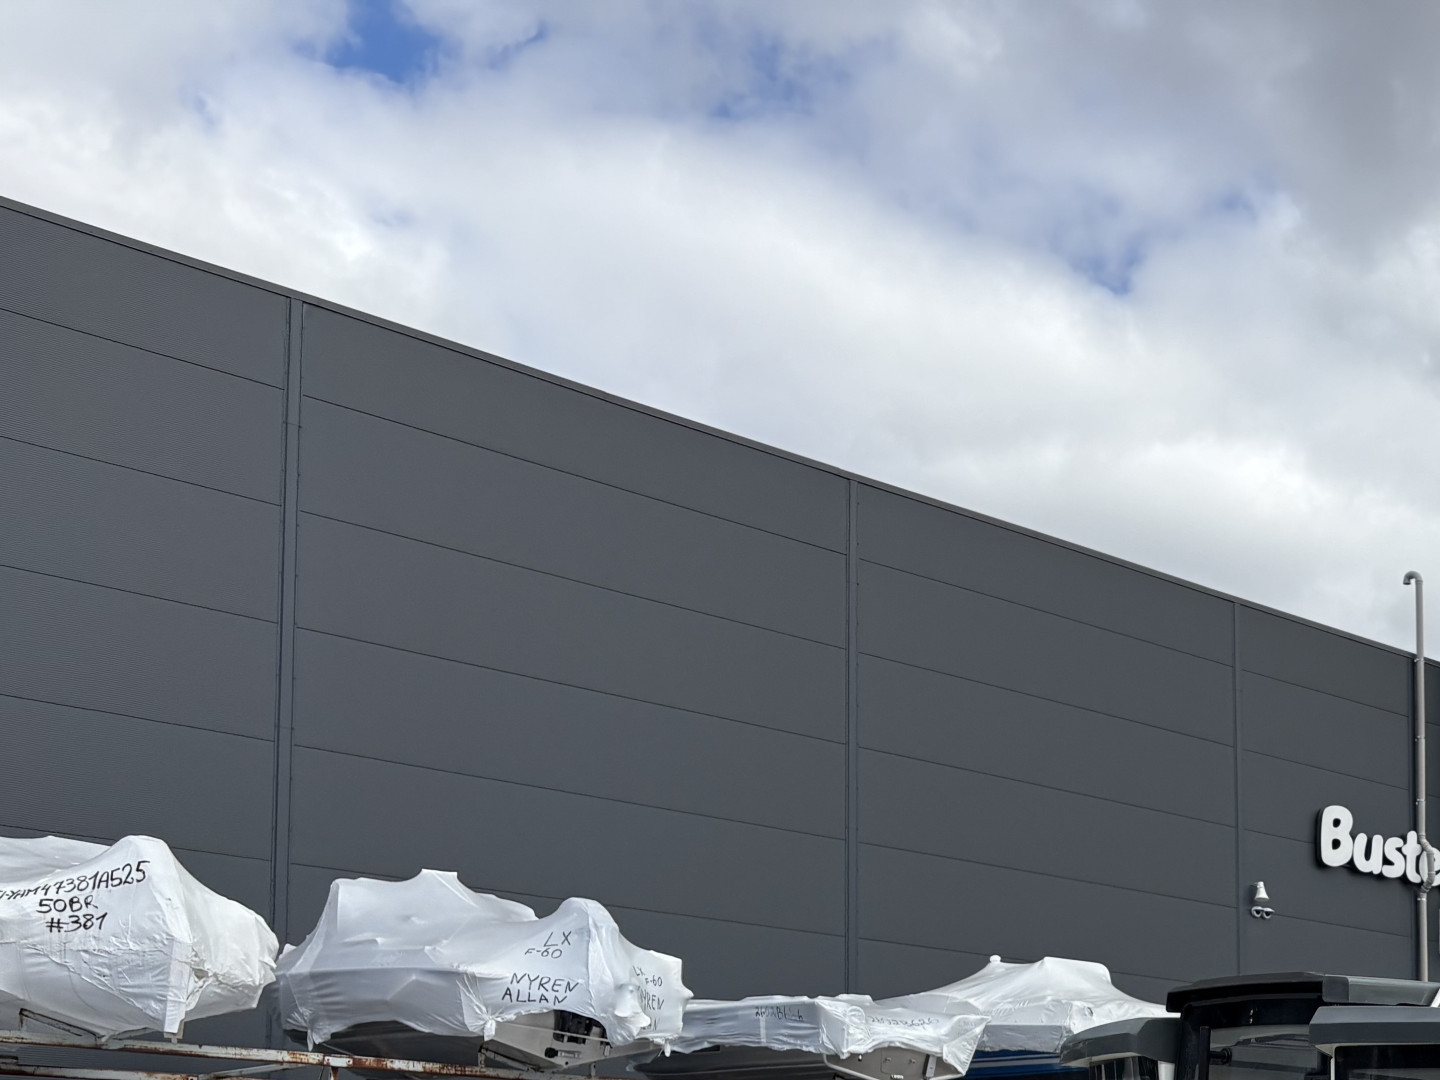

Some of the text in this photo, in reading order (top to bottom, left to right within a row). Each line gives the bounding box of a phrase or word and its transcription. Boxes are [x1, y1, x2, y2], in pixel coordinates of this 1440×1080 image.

[0, 860, 150, 900] I-YAM47381A525
[36, 895, 98, 913] 50BR
[45, 912, 108, 933] #381
[543, 931, 572, 947] LX
[524, 948, 563, 959] F-60
[510, 972, 580, 994] NYREN
[502, 987, 568, 1006] ALLAN
